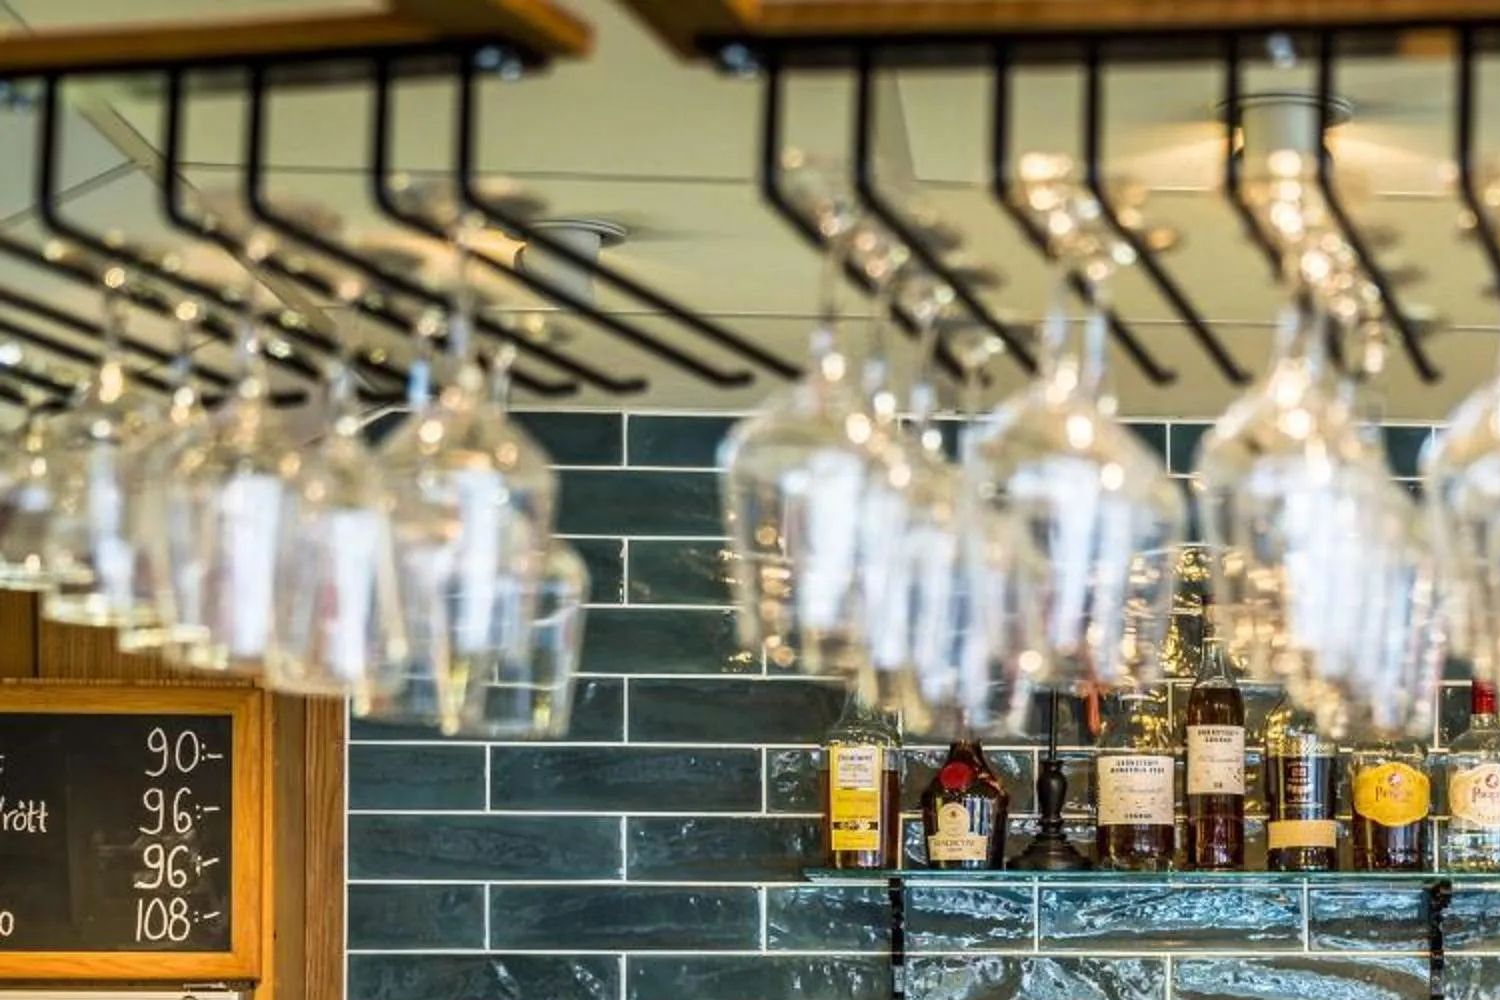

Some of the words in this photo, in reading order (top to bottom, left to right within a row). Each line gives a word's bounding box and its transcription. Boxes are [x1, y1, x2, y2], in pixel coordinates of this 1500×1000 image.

[140, 788, 220, 835] 96:-
[134, 844, 219, 888] 96:-
[135, 897, 221, 941] 108:-
